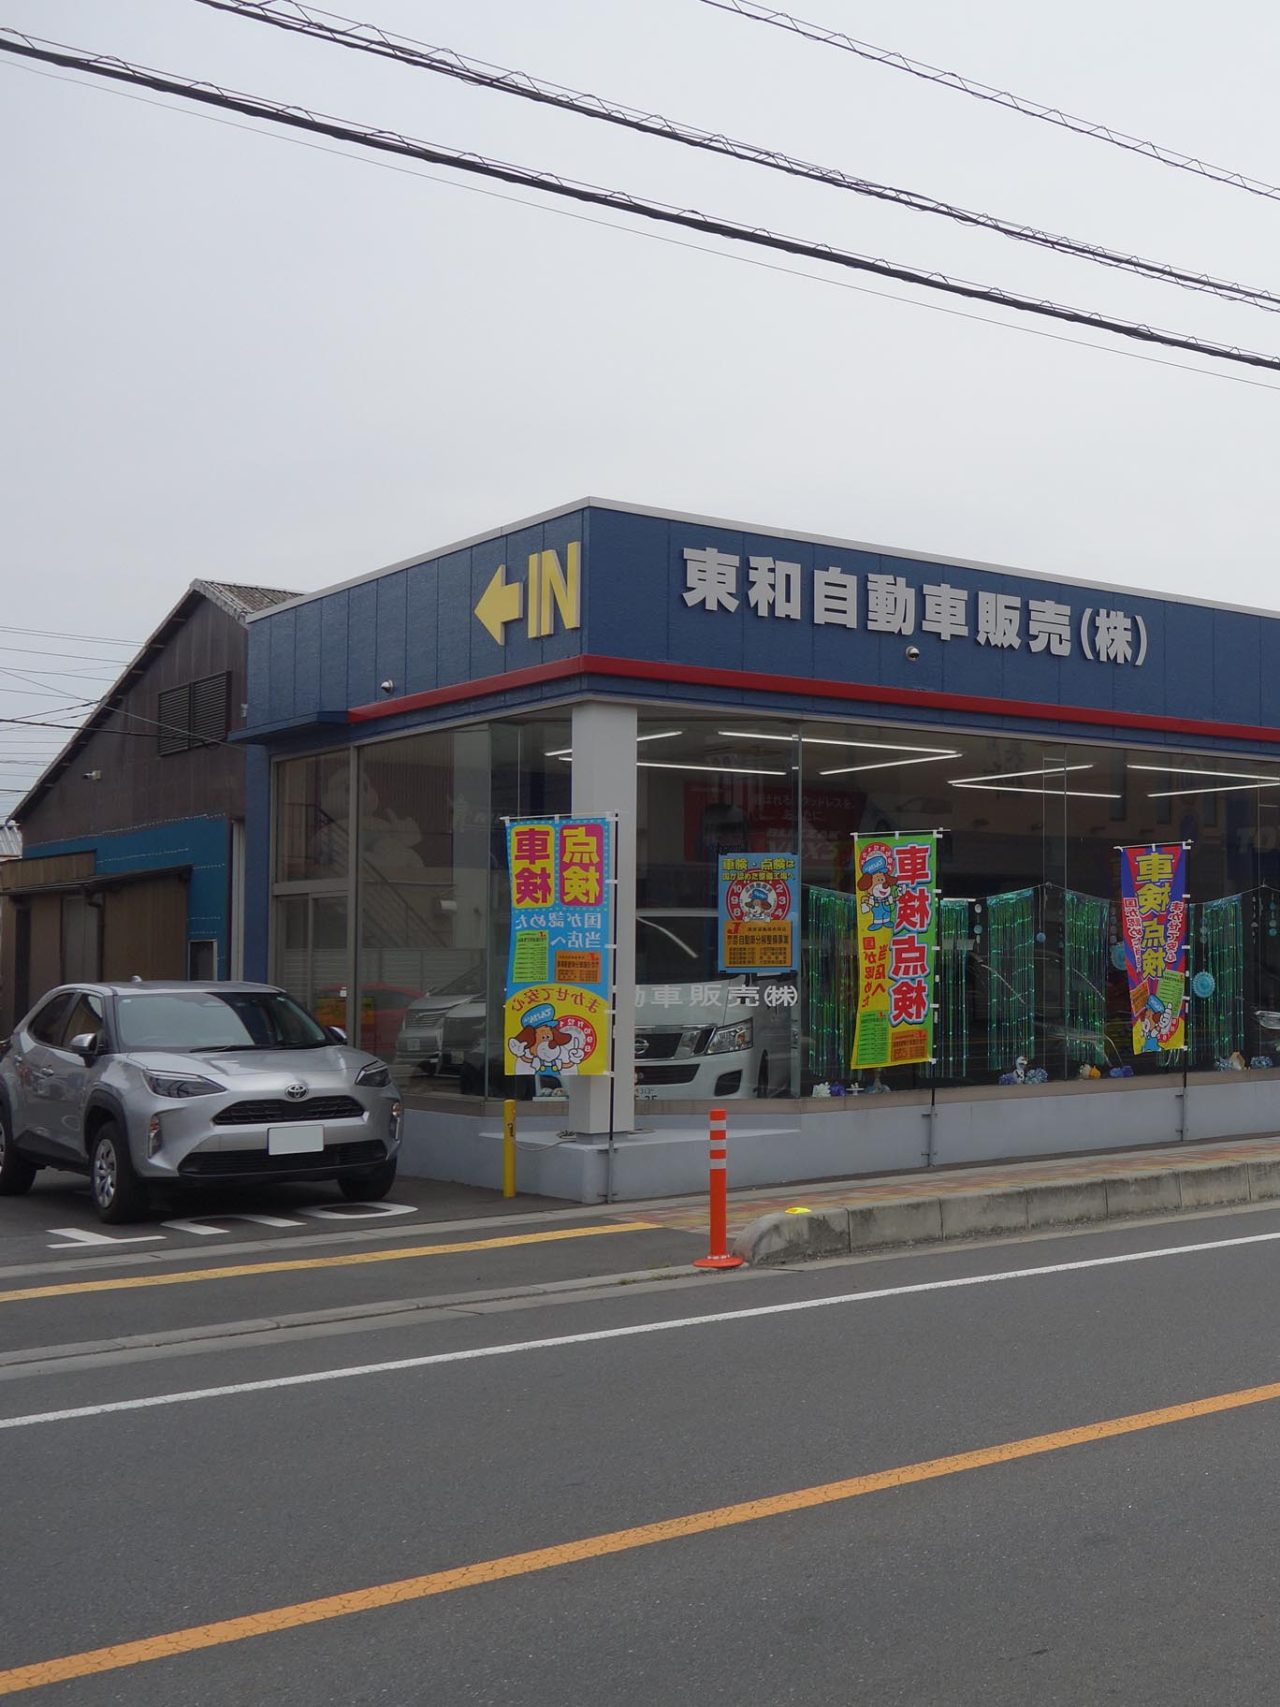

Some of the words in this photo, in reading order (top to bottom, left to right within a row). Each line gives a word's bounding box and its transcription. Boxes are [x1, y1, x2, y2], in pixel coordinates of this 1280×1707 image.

[528, 542, 581, 638] IN
[682, 547, 1148, 667] 東和自動車販売(株)
